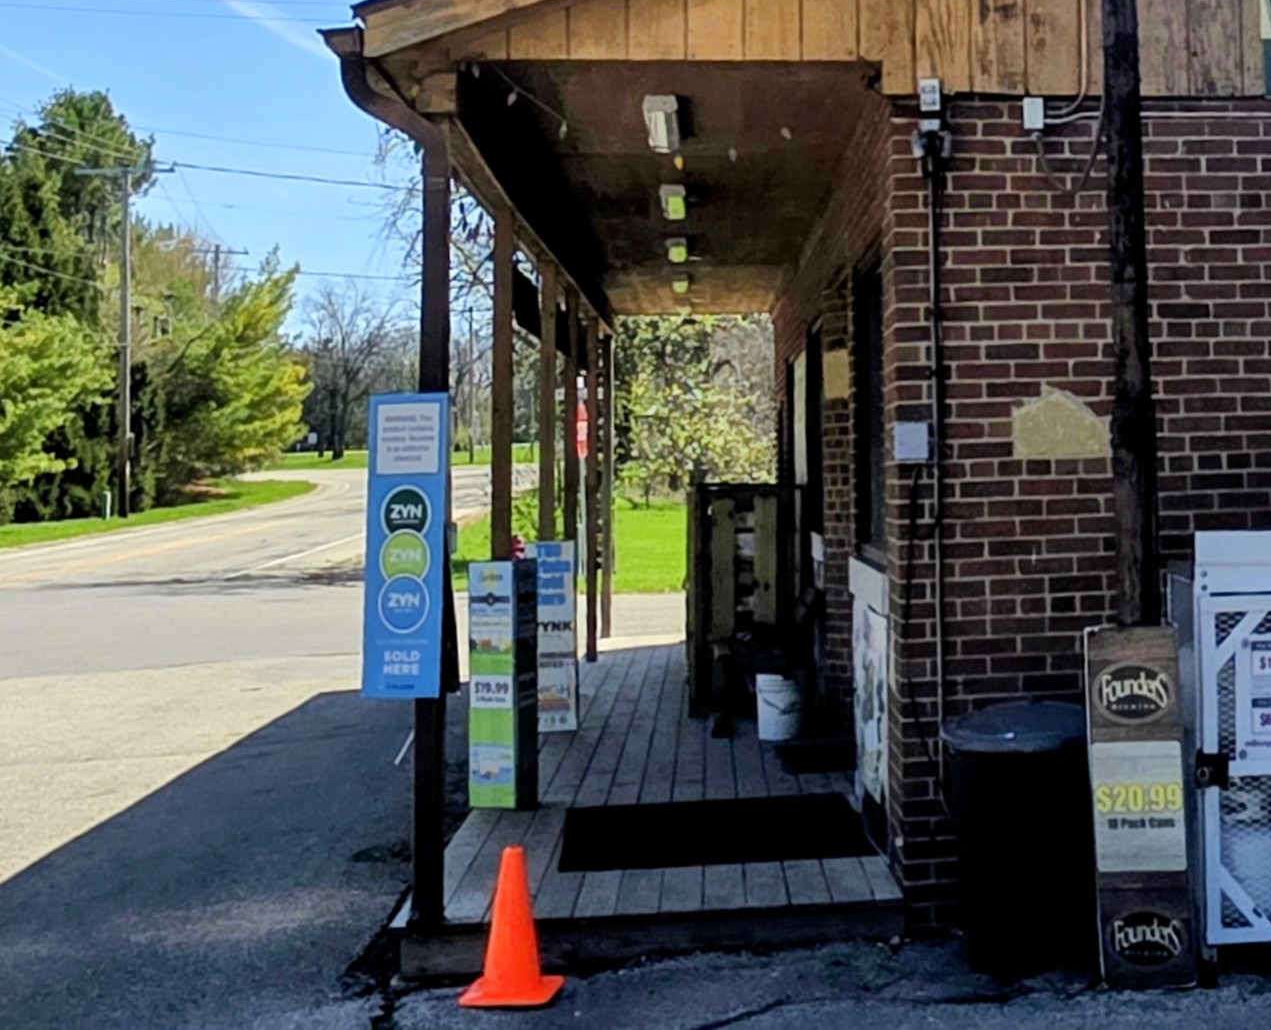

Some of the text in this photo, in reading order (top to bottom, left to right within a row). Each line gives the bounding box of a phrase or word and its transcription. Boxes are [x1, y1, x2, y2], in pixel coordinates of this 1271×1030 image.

[390, 504, 422, 519] ZYN
[388, 548, 422, 563] ZYN
[387, 593, 420, 608] ZYN
[384, 651, 420, 662] SOLD
[384, 664, 419, 675] HERE
[474, 681, 509, 695] $19.99
[1102, 671, 1169, 710] Founders
[1096, 783, 1183, 815] $20.99
[1114, 920, 1182, 957] Founders
